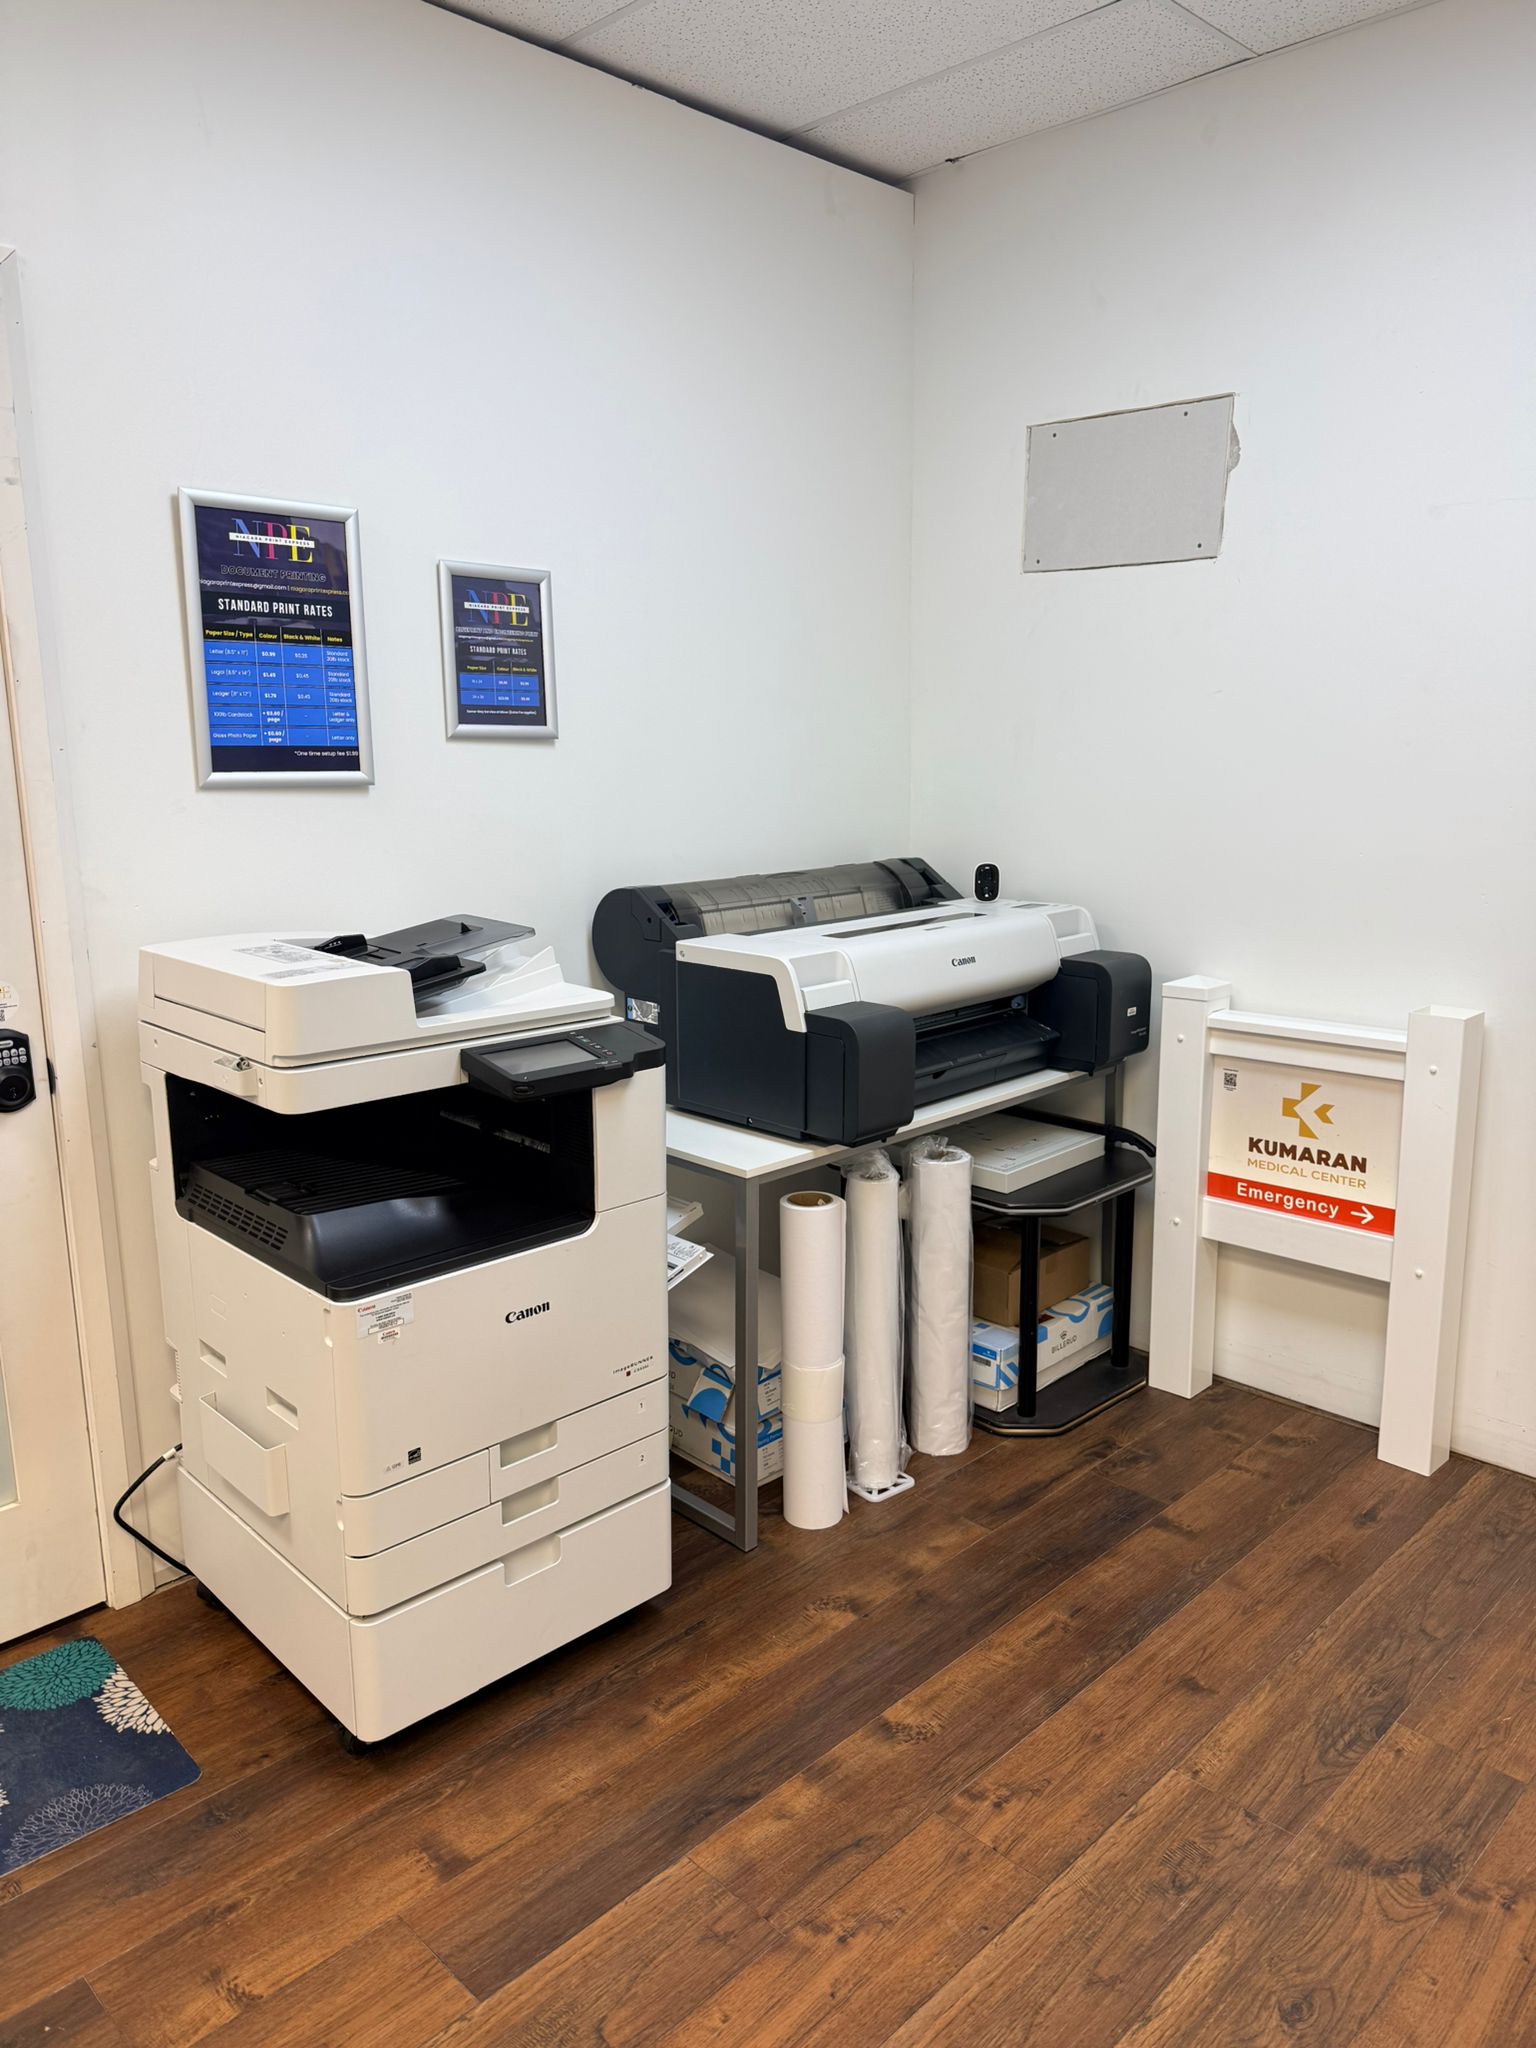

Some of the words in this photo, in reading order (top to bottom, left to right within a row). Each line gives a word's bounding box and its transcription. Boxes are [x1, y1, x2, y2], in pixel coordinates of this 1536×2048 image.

[231, 517, 313, 563] NPE
[235, 534, 262, 542] NIAGARA
[220, 564, 278, 578] DOCUMENT
[280, 569, 326, 582] PRINTING
[218, 598, 270, 614] STANDARD
[273, 602, 300, 615] PRINT
[304, 604, 333, 618] RATES
[466, 588, 528, 626] NPE
[205, 629, 222, 637] Paper
[470, 645, 495, 654] STANDARD
[952, 956, 976, 967] Canon
[1248, 1136, 1367, 1174] KUMARAN
[1247, 1158, 1308, 1178] MEDICAL
[1311, 1170, 1366, 1189] CENTER
[1236, 1182, 1339, 1218] Emergency
[505, 1302, 550, 1324] Canon
[1051, 1334, 1078, 1354] BILLERUD
[612, 1356, 653, 1374] imageRUNNER
